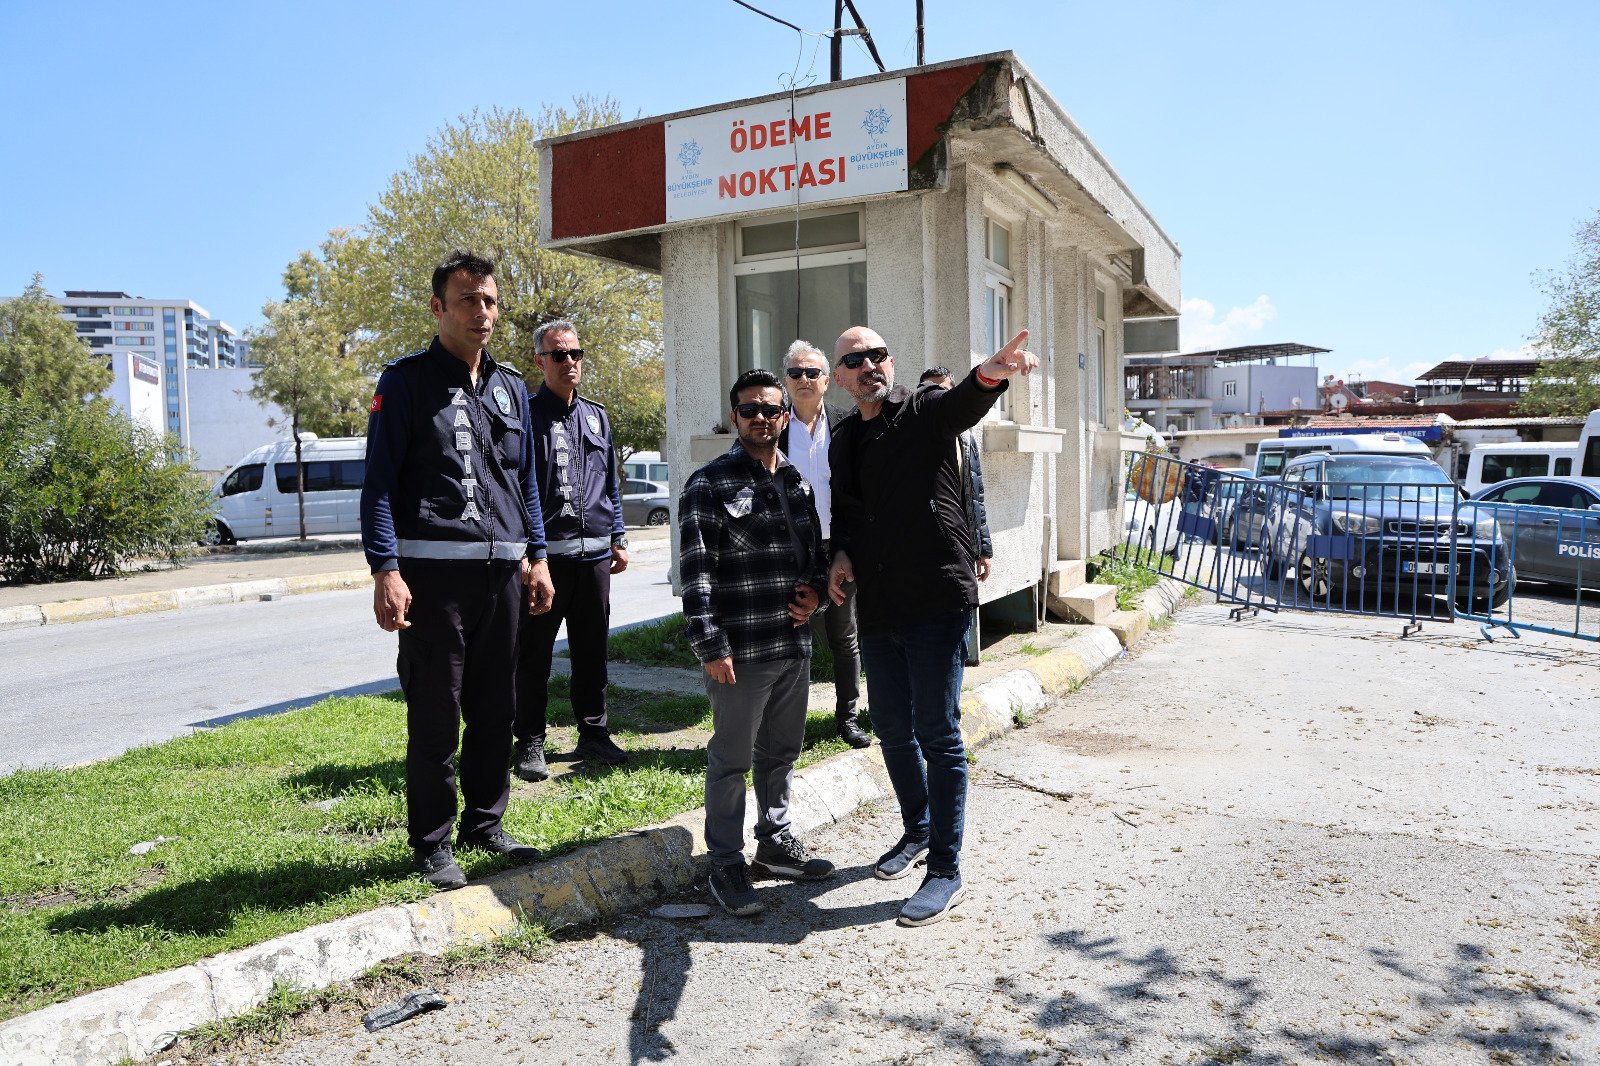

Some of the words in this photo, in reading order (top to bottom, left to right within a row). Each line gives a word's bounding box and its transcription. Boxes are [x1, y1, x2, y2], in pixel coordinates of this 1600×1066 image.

[730, 111, 832, 154] ÖDEME
[866, 142, 888, 151] AYDIN
[850, 148, 905, 163] BÜYÜKŞEHİR
[667, 178, 713, 192] BÜYÜKŞEHİR
[681, 173, 700, 181] AYDIN
[718, 156, 846, 201] NOKTASI
[448, 387, 481, 521] ZABITA
[552, 420, 576, 518] ZABITA
[1558, 543, 1600, 559] POLİS
